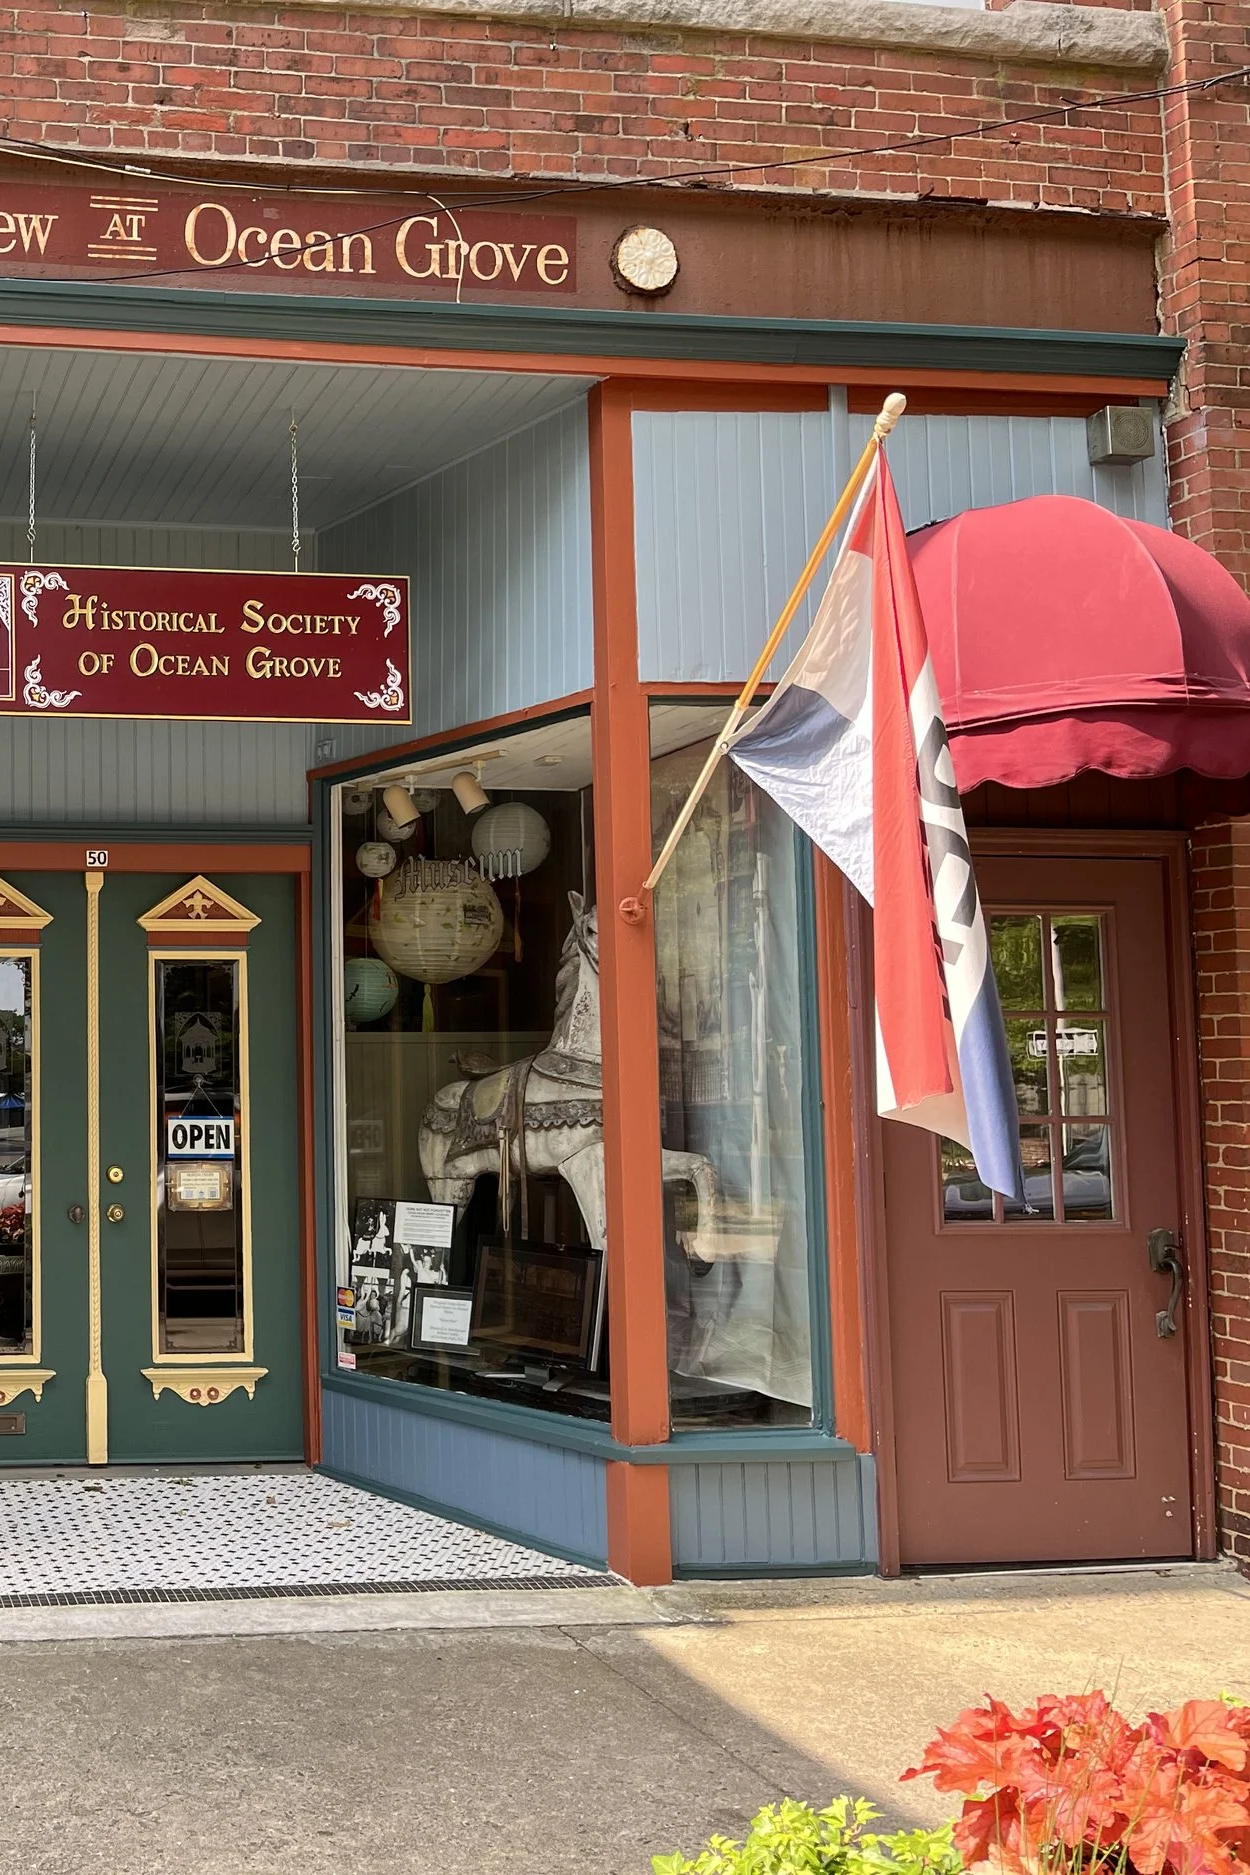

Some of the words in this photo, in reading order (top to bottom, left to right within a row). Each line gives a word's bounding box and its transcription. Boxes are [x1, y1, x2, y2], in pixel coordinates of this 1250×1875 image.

[100, 213, 145, 242] AT
[184, 202, 377, 276] Ocean
[395, 216, 572, 286] Grove
[87, 851, 107, 865] 50
[395, 848, 523, 902] Museum
[171, 1124, 231, 1150] OPEN
[340, 1312, 352, 1322] VISA
